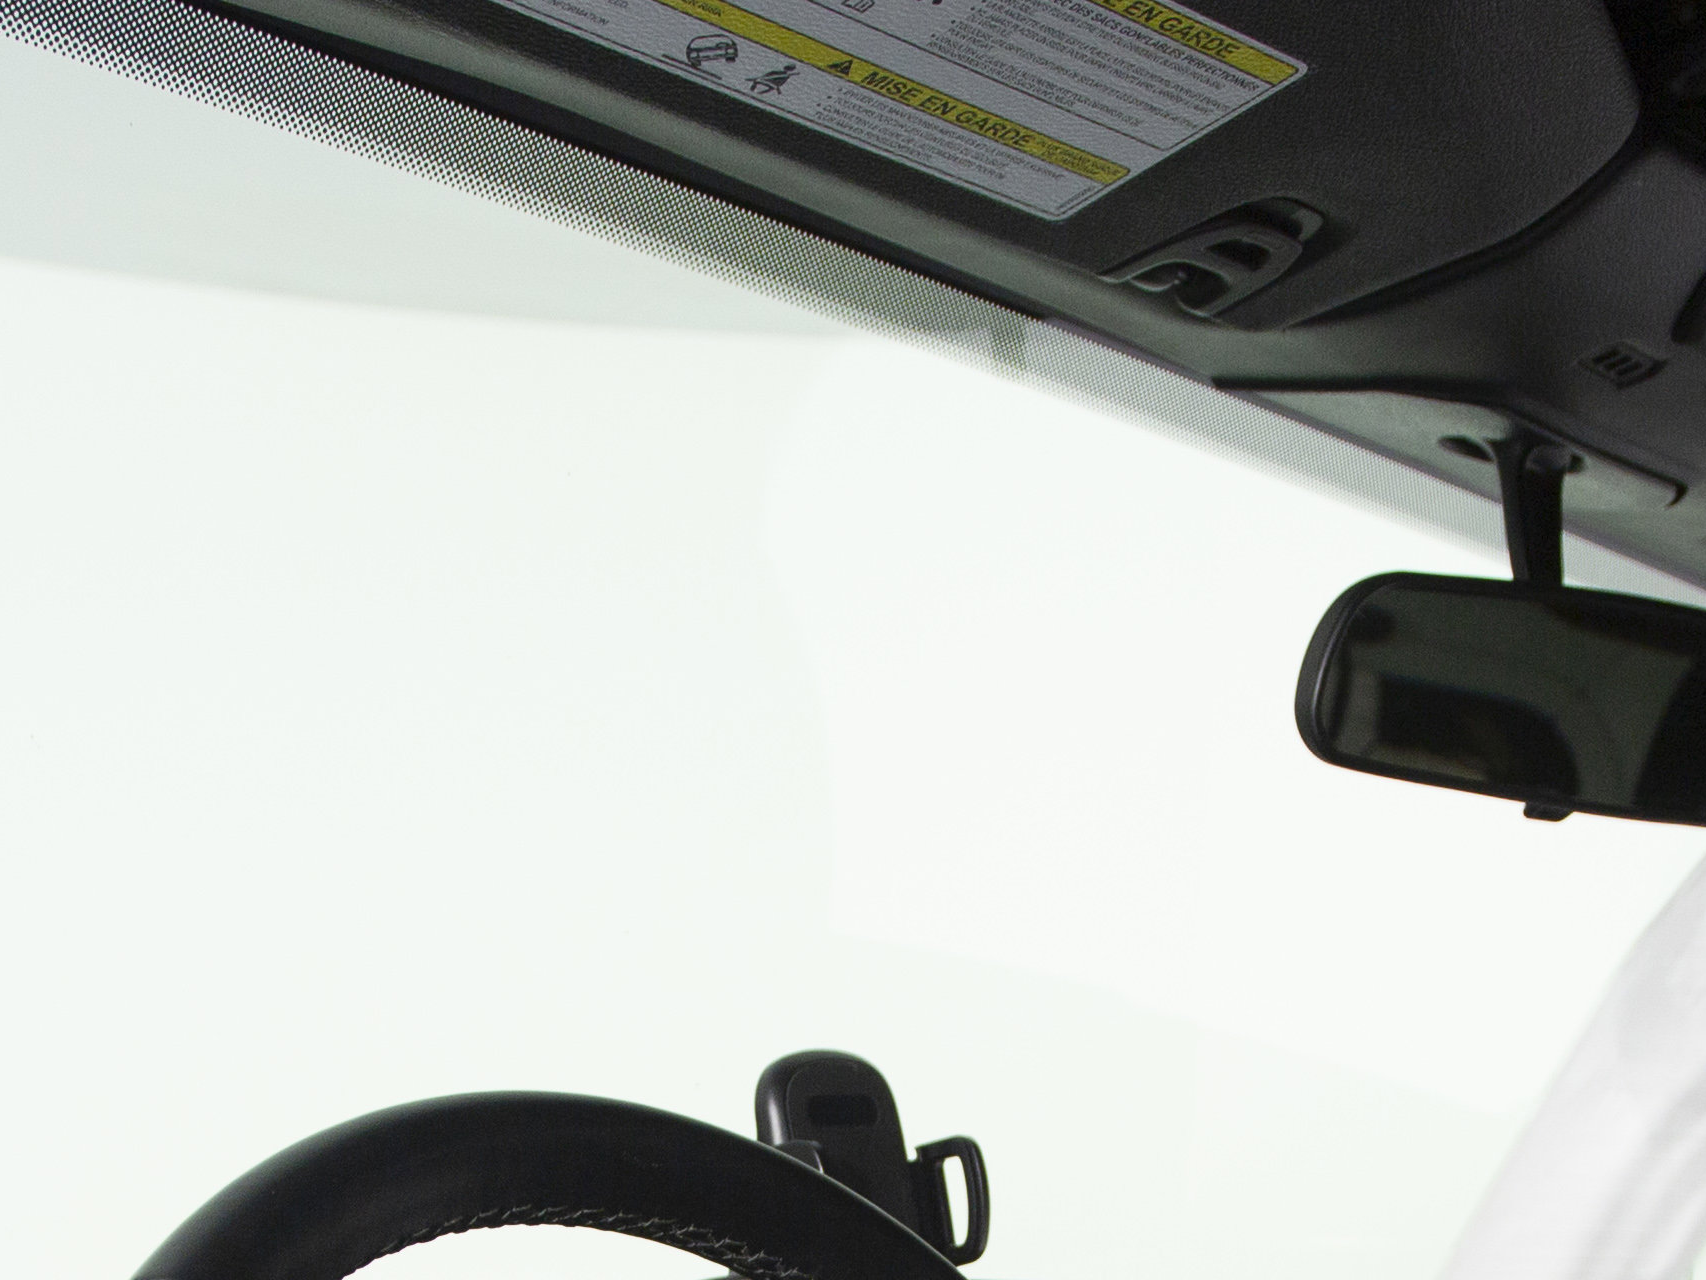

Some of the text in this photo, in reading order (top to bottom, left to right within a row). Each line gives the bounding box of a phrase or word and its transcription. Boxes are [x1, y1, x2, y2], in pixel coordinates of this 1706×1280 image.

[1092, 12, 1121, 31] SACS
[1125, 1, 1240, 59] EN GARDE
[861, 70, 1037, 148] MISE EN GARDE
